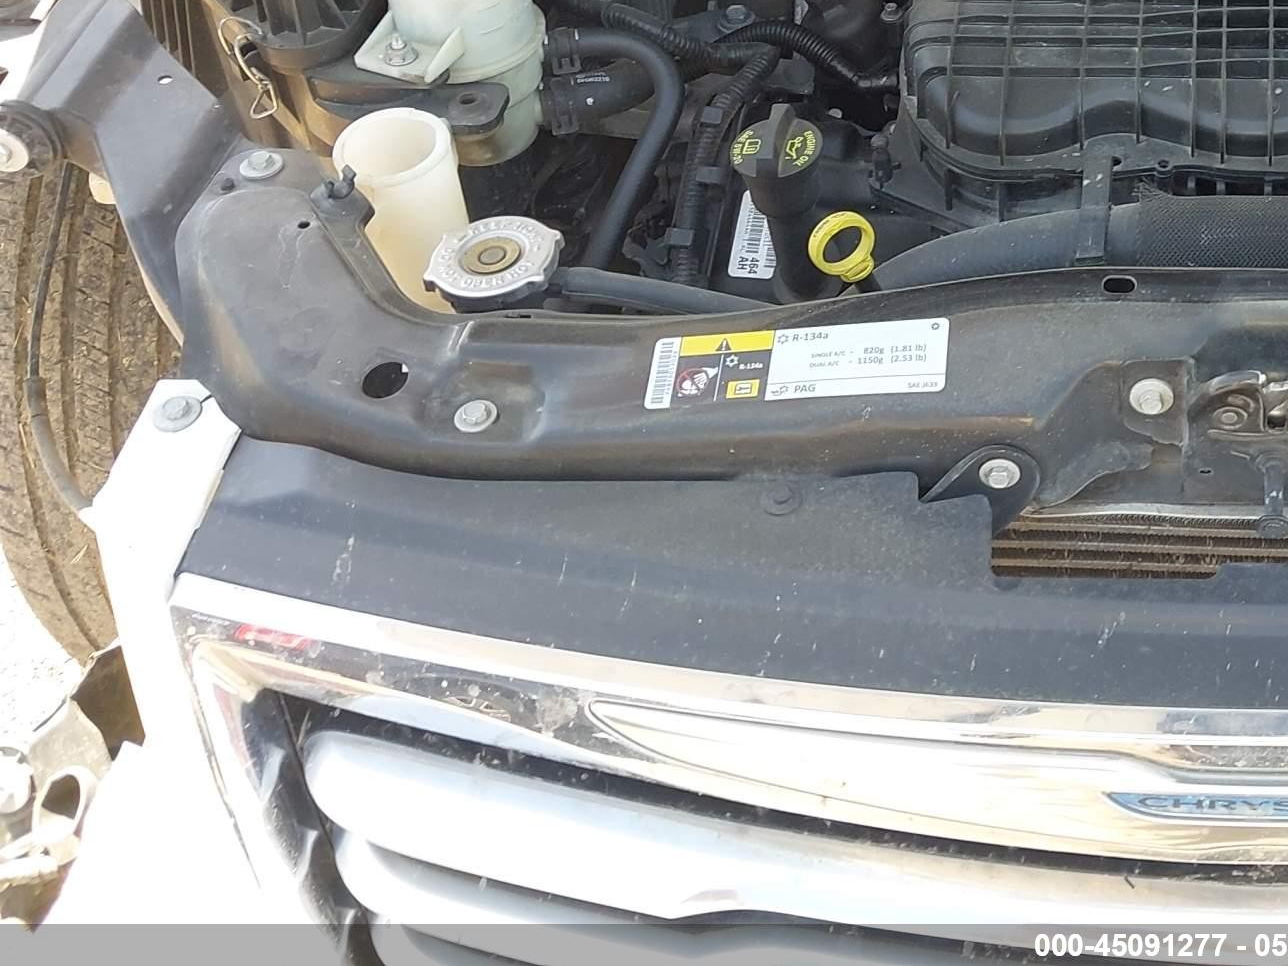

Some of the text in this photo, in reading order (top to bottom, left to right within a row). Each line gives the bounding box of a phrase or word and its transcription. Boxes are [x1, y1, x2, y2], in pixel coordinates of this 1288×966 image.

[737, 256, 749, 270] AH
[747, 257, 760, 274] 464
[792, 332, 829, 342] R-134a
[915, 343, 927, 353] lb)
[915, 353, 927, 362] lb)
[793, 384, 816, 393] PAG
